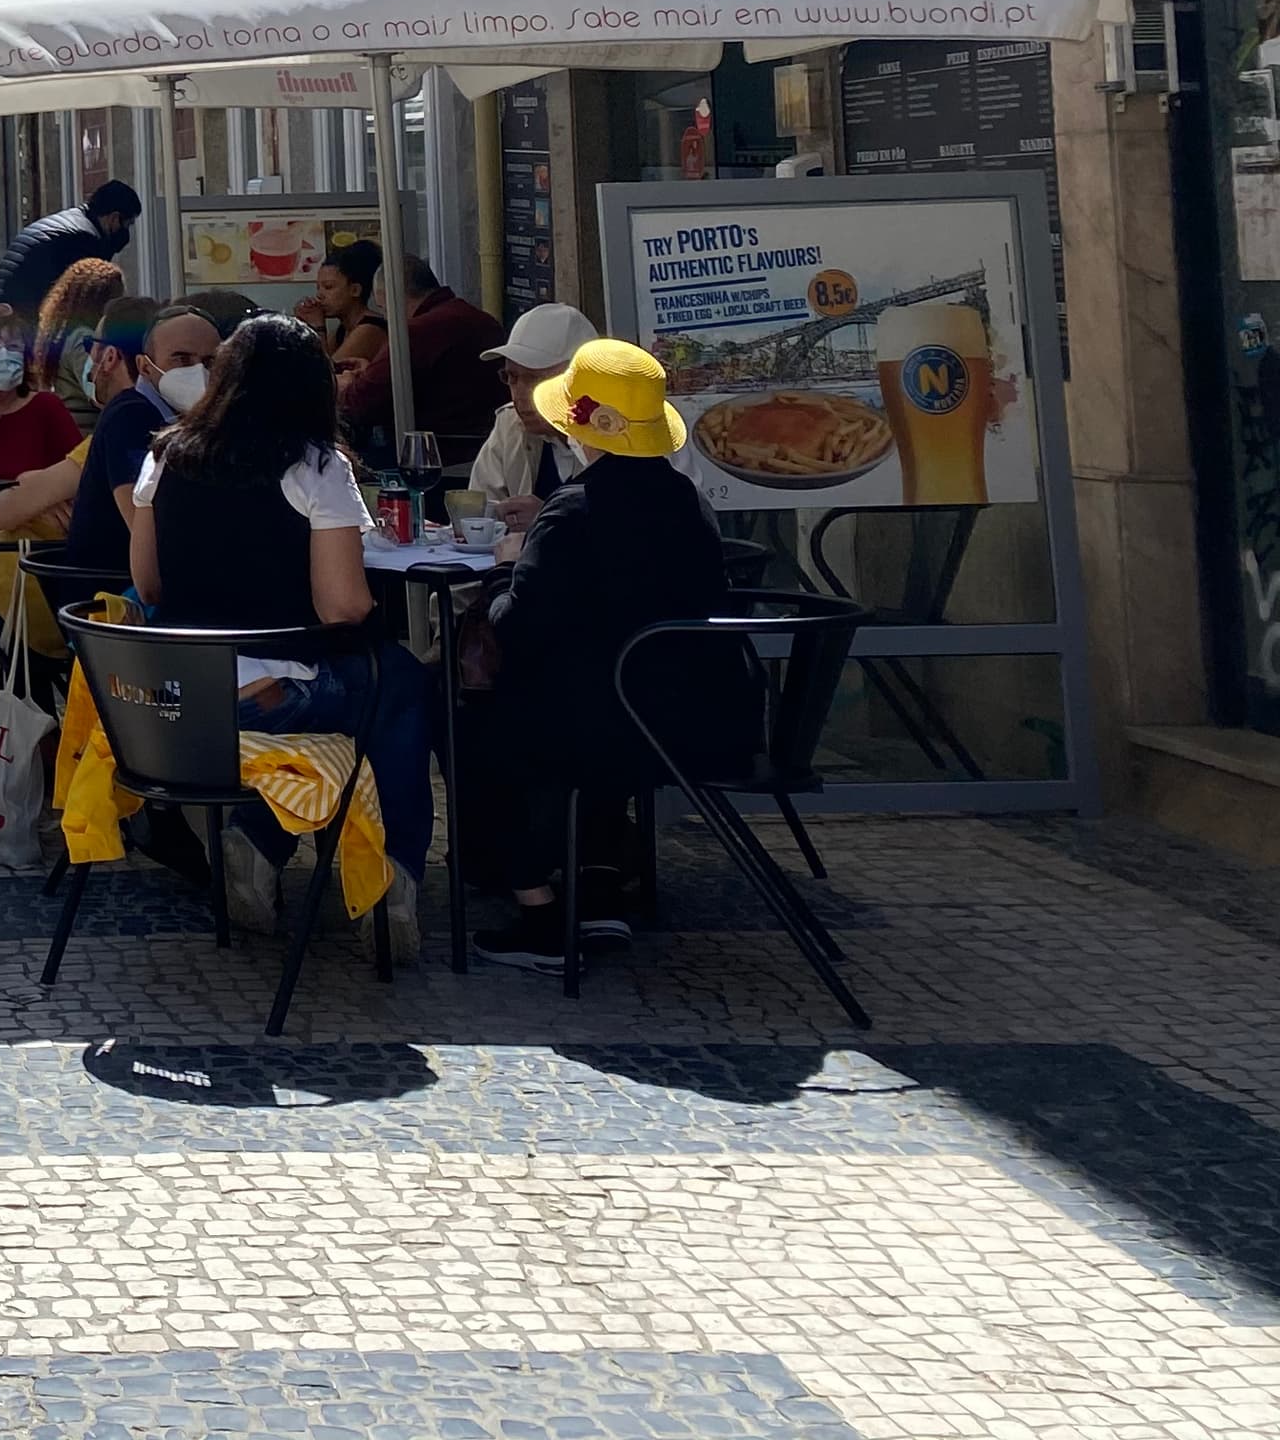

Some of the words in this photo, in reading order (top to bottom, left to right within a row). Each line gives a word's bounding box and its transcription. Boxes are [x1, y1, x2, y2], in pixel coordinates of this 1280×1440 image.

[55, 26, 215, 67] guarda-sol
[223, 24, 302, 46] torna
[312, 24, 331, 41] o
[342, 21, 371, 39] ar
[384, 14, 453, 38] mais
[463, 10, 555, 39] limpo.
[653, 4, 722, 27] mais
[734, 6, 782, 26] em
[794, 0, 1039, 30] www.buondi.pt
[643, 236, 673, 258] TRY
[649, 256, 734, 283] AUTHENTIC
[739, 245, 823, 273] FLAVOURS!
[654, 290, 730, 311] FRANCESINHA
[814, 280, 855, 308] 8,5€
[666, 309, 693, 324] FRIED
[695, 307, 713, 320] EGG
[724, 303, 752, 318] LOCAL
[753, 300, 781, 315] CRAFT
[783, 297, 807, 311] BEER
[919, 363, 949, 396] N
